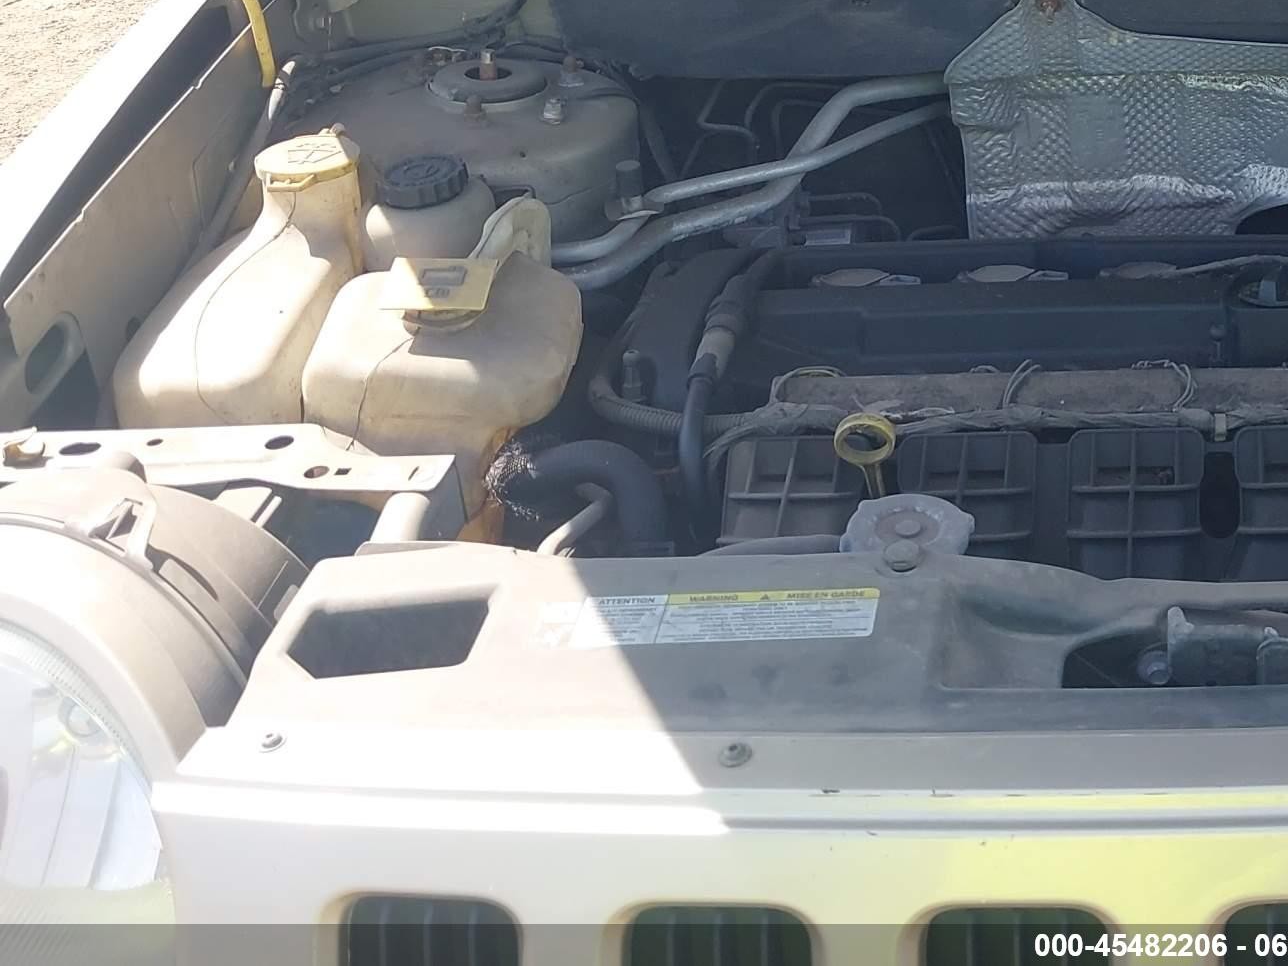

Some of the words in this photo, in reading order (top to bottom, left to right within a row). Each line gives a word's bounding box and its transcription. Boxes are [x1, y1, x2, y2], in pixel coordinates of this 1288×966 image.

[689, 593, 738, 602] WARNING
[786, 592, 812, 600] MISE
[815, 591, 828, 599] EN
[831, 589, 864, 598] GARDE
[598, 596, 656, 605] ATTENTION
